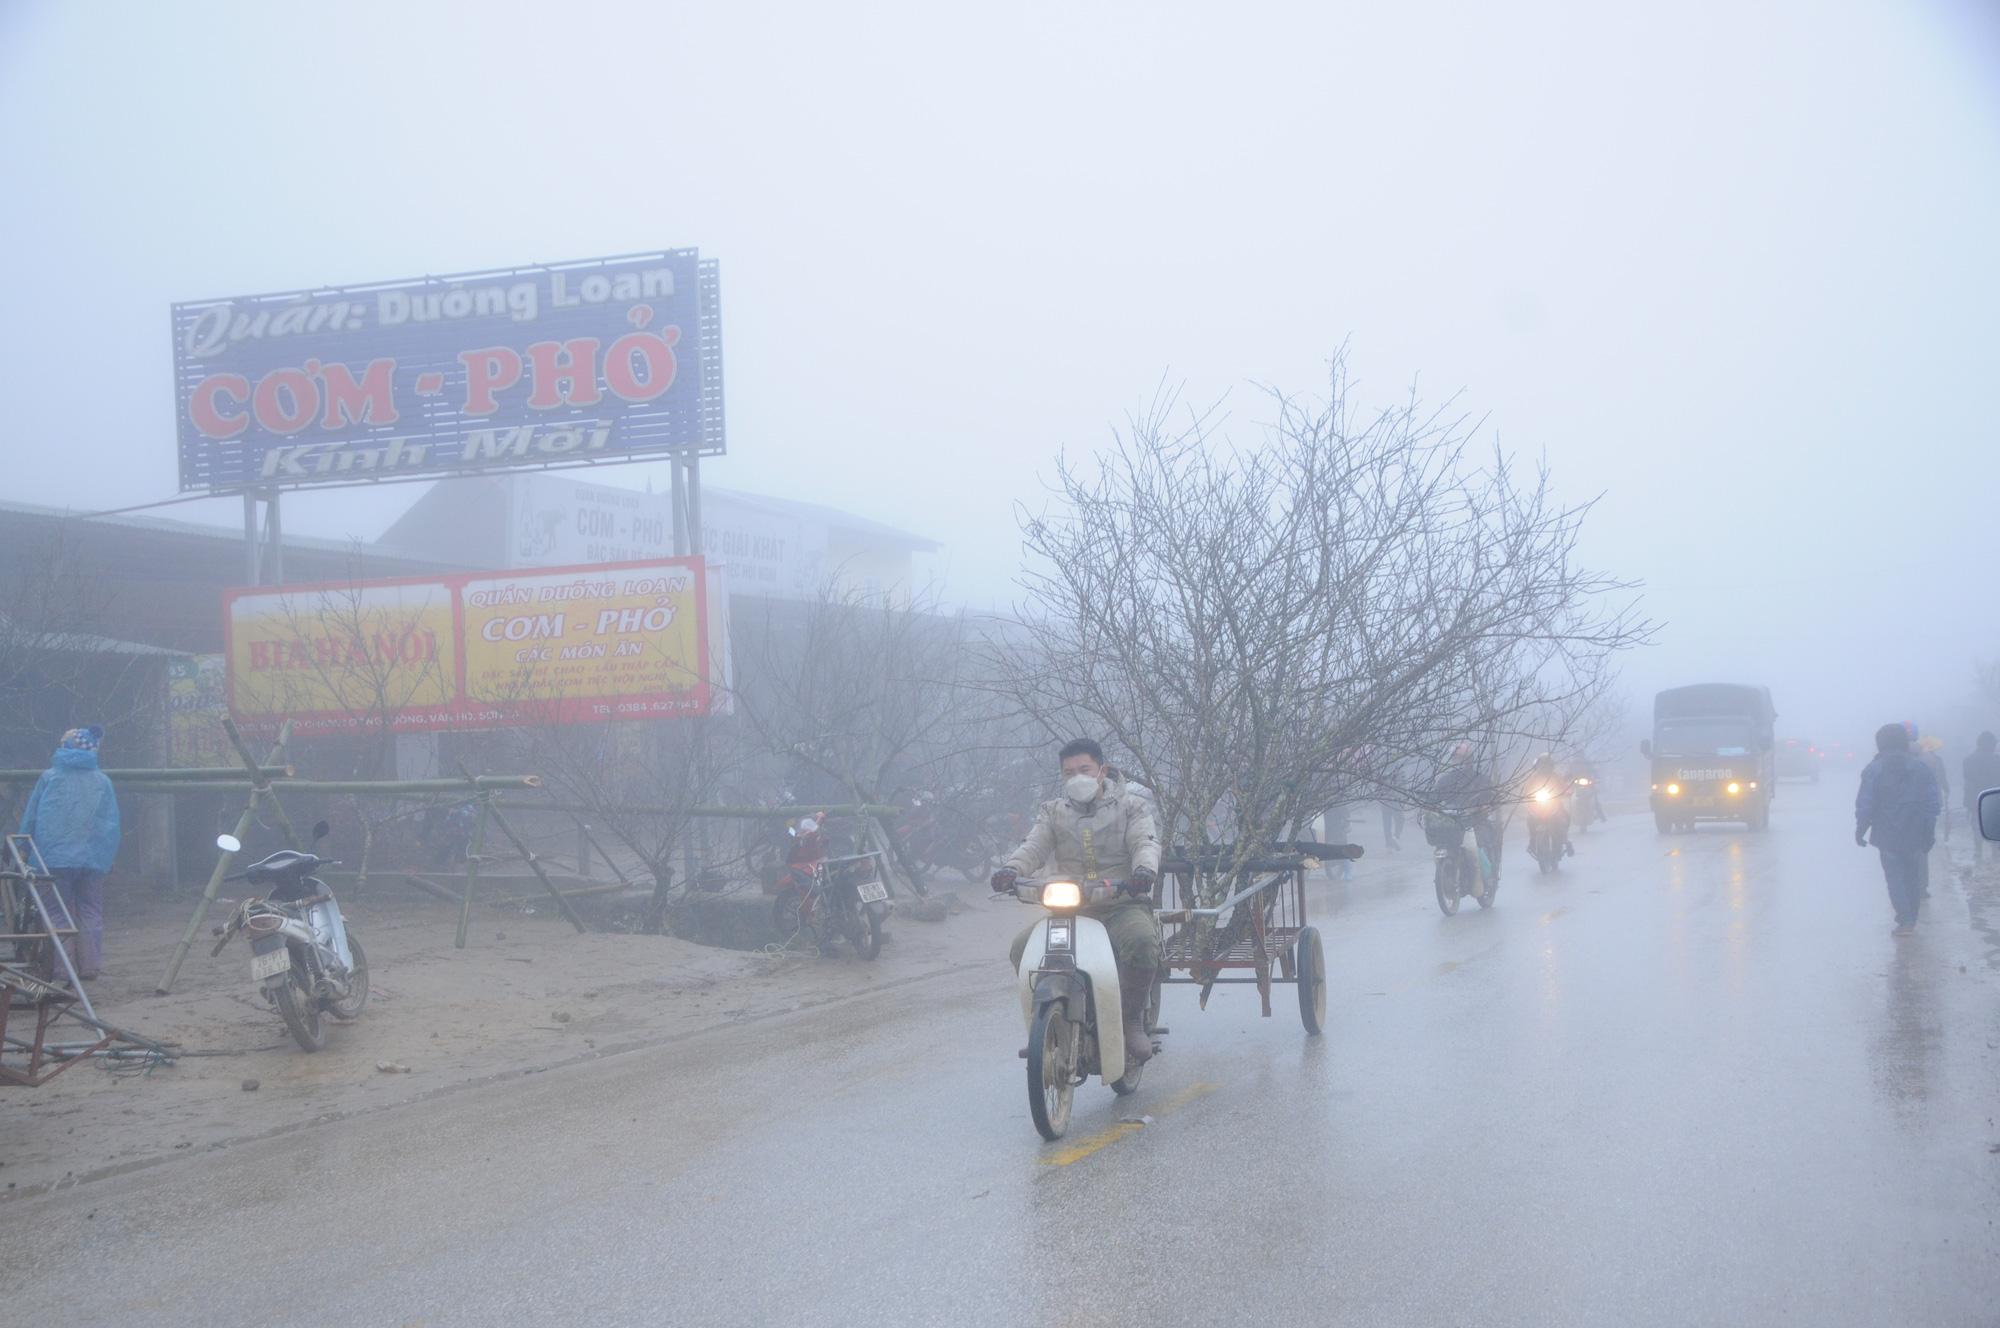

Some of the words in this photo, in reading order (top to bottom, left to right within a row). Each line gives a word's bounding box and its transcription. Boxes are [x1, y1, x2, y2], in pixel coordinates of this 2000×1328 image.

[184, 291, 366, 358] Quán:
[551, 268, 675, 307] Loan
[189, 358, 399, 438] CƠM
[458, 303, 681, 416] PHỞ
[260, 438, 428, 478] Kính
[461, 419, 613, 460] Mời
[470, 584, 534, 608] QUÁN
[624, 575, 688, 596] LOAN
[481, 612, 566, 641] CƠM
[594, 596, 679, 635] PHỞ
[249, 638, 311, 672] BIA
[515, 645, 554, 664] CÁC
[559, 640, 607, 660] MÓN
[613, 639, 644, 657] ĂN
